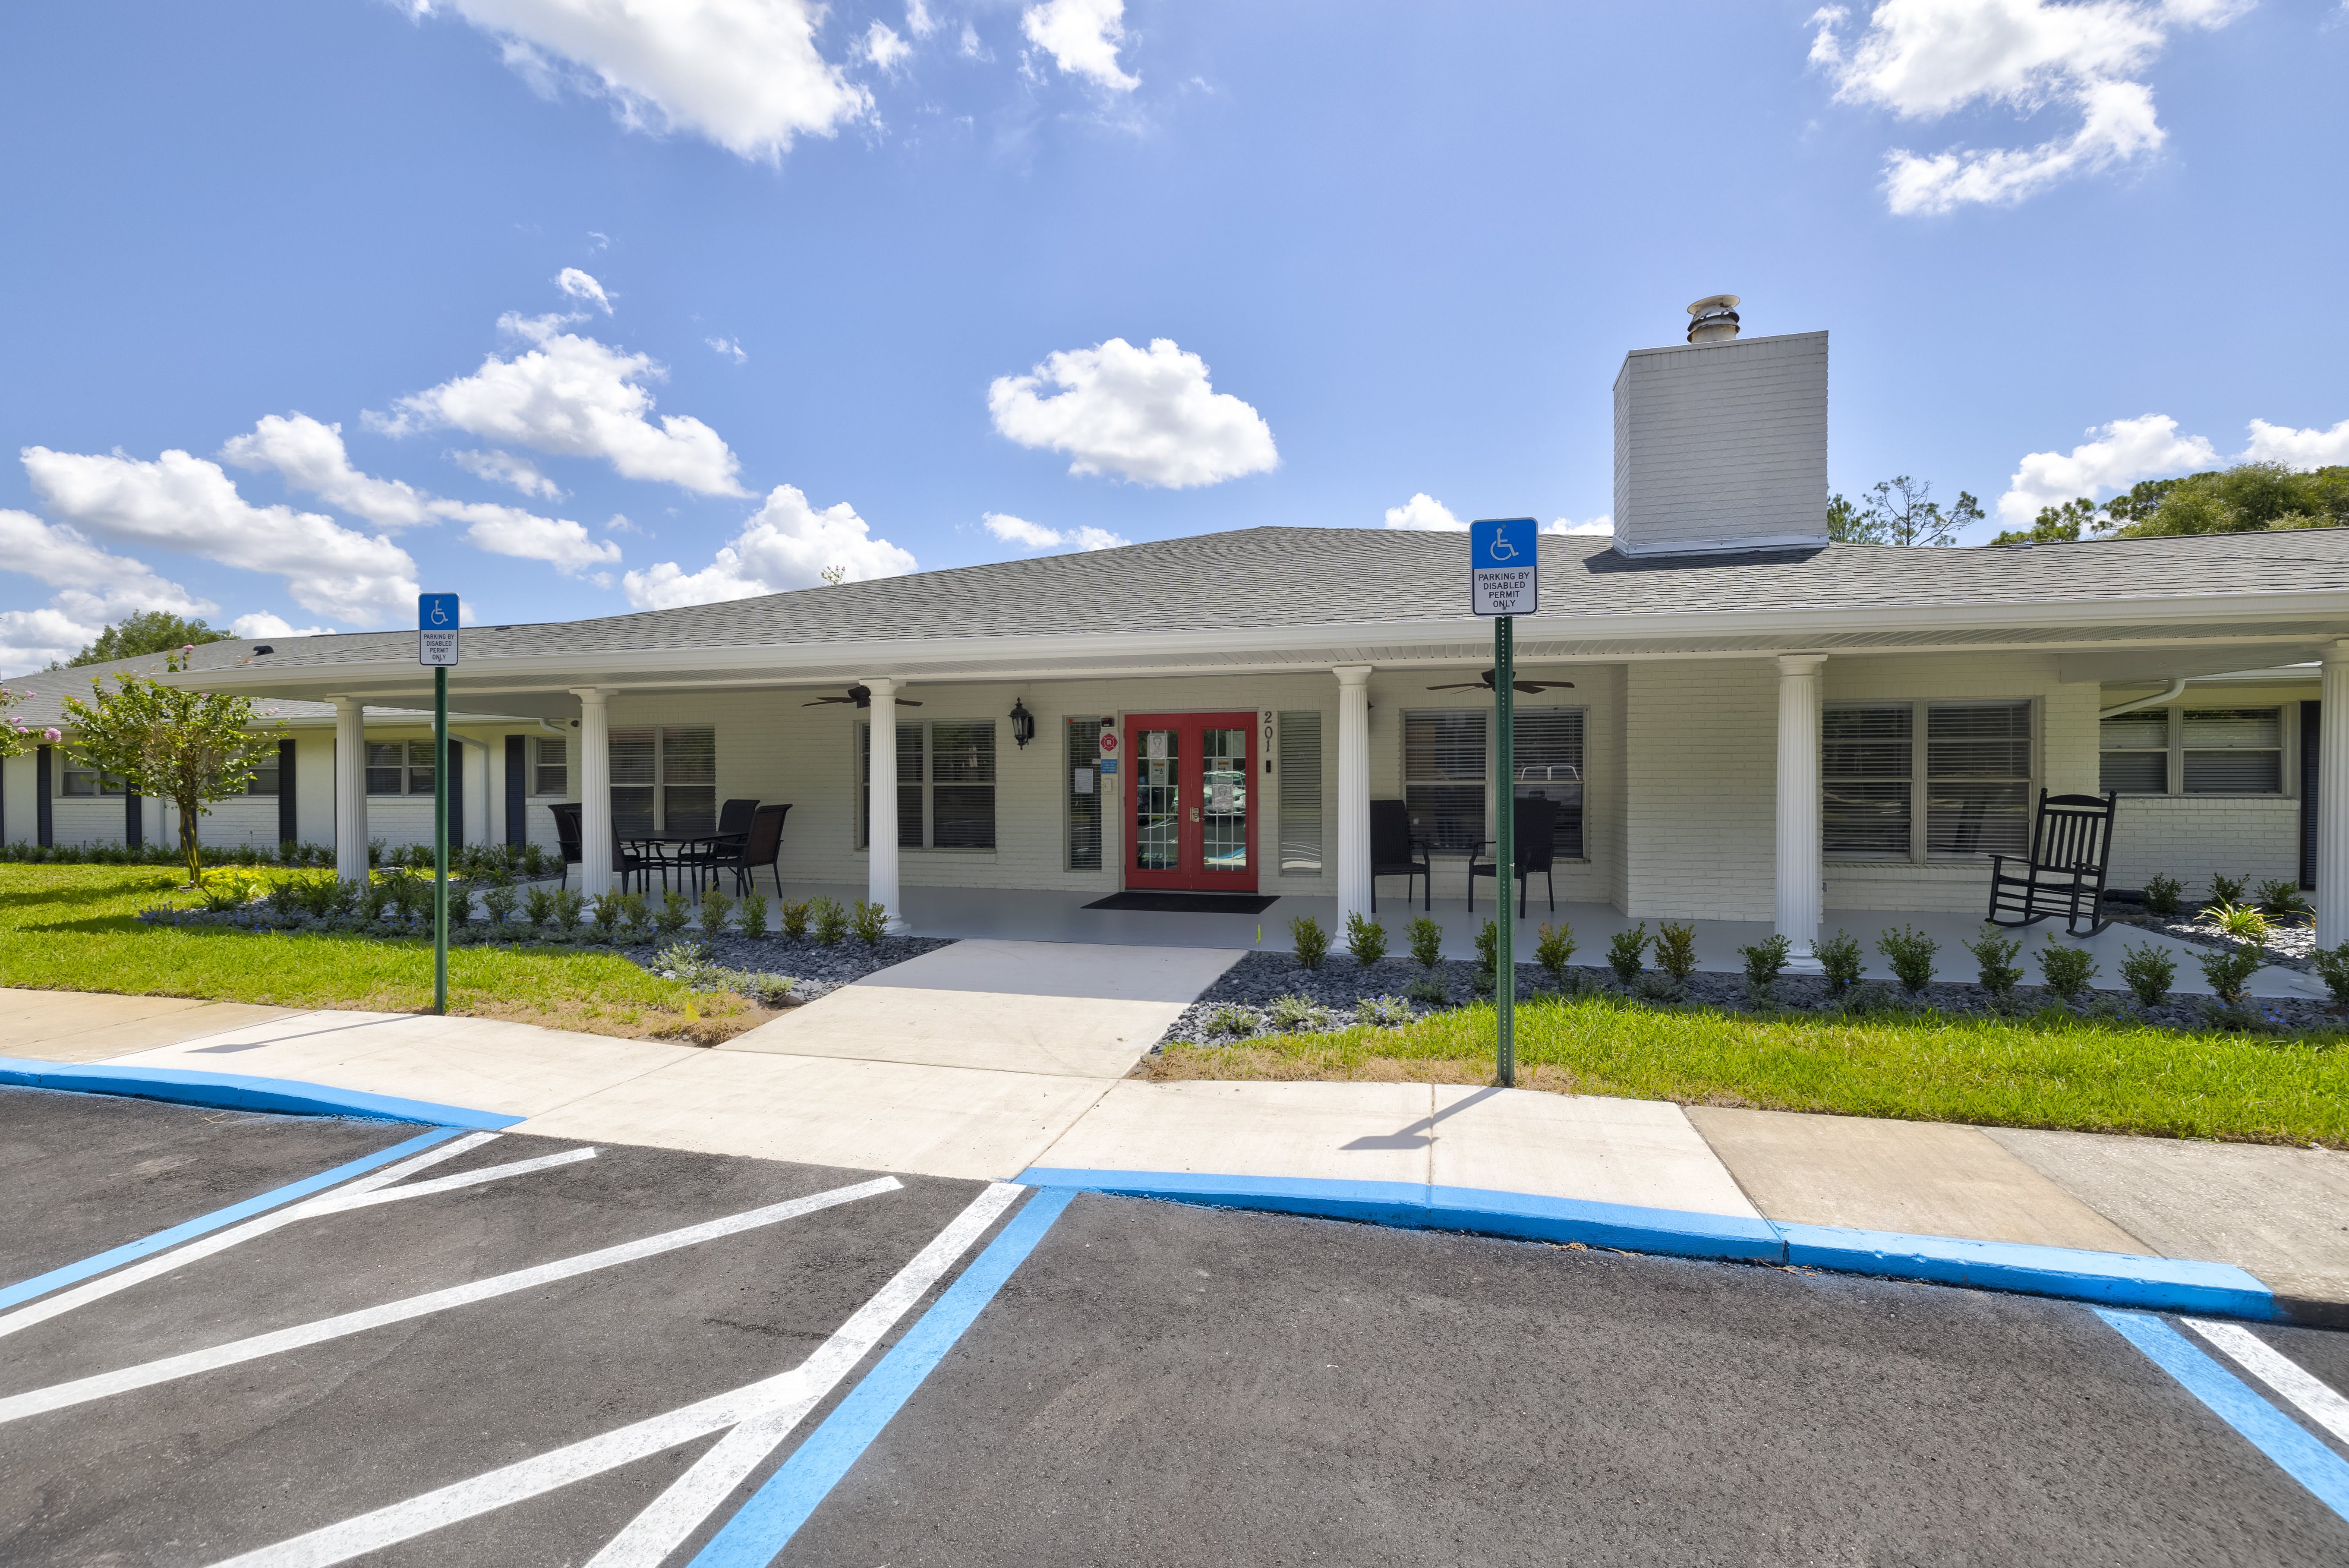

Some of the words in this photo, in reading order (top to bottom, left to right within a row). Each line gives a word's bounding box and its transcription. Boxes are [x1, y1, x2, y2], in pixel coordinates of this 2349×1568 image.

[1479, 572, 1515, 581] PARKING
[1483, 581, 1525, 590] DISABLED
[1489, 590, 1520, 599] PERMIT
[1264, 711, 1273, 752] 201
